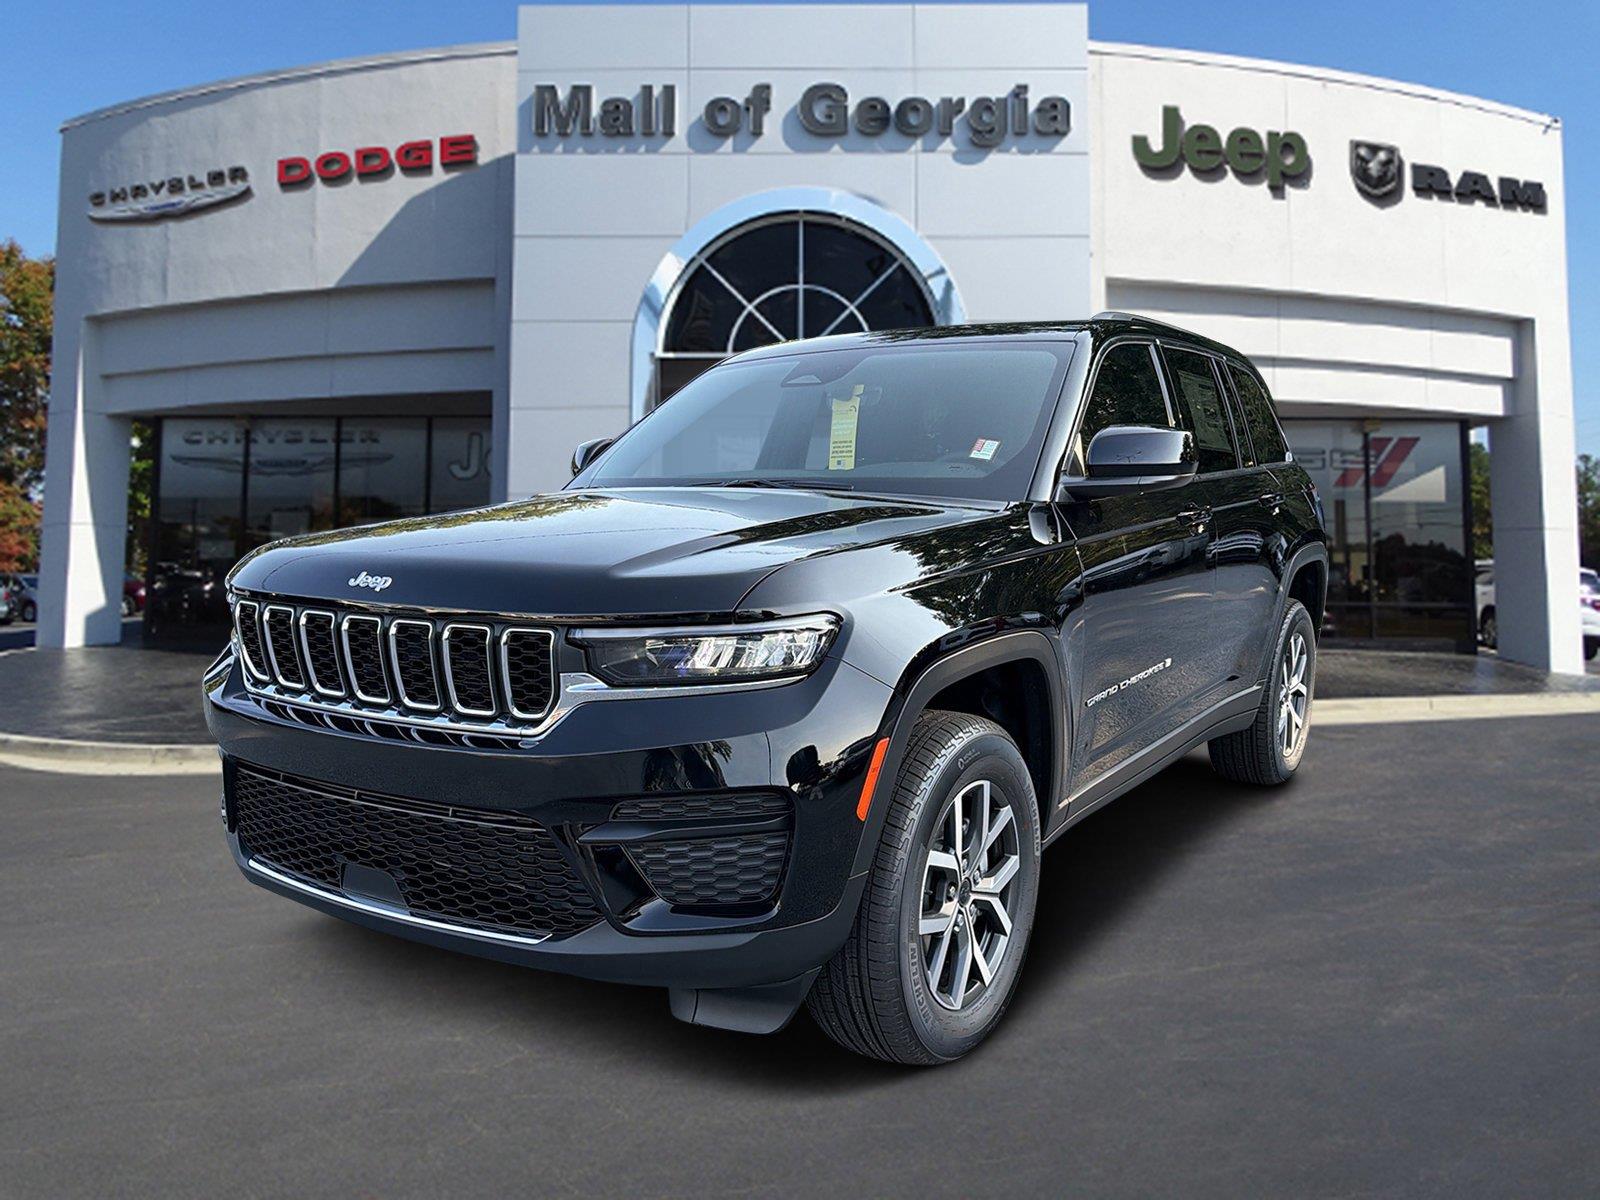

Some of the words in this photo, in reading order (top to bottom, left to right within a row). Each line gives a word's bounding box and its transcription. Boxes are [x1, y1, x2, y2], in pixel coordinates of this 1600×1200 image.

[533, 84, 677, 138] Mall
[704, 83, 772, 137] of
[800, 83, 1072, 148] Georgia
[277, 134, 477, 186] DODGE
[1131, 105, 1309, 189] Jeep
[90, 166, 249, 206] CHRYSLER
[1410, 163, 1546, 212] RAM
[348, 571, 393, 592] Jeep
[1087, 685, 1119, 707] GRAND
[1120, 661, 1165, 690] CHEROKEE
